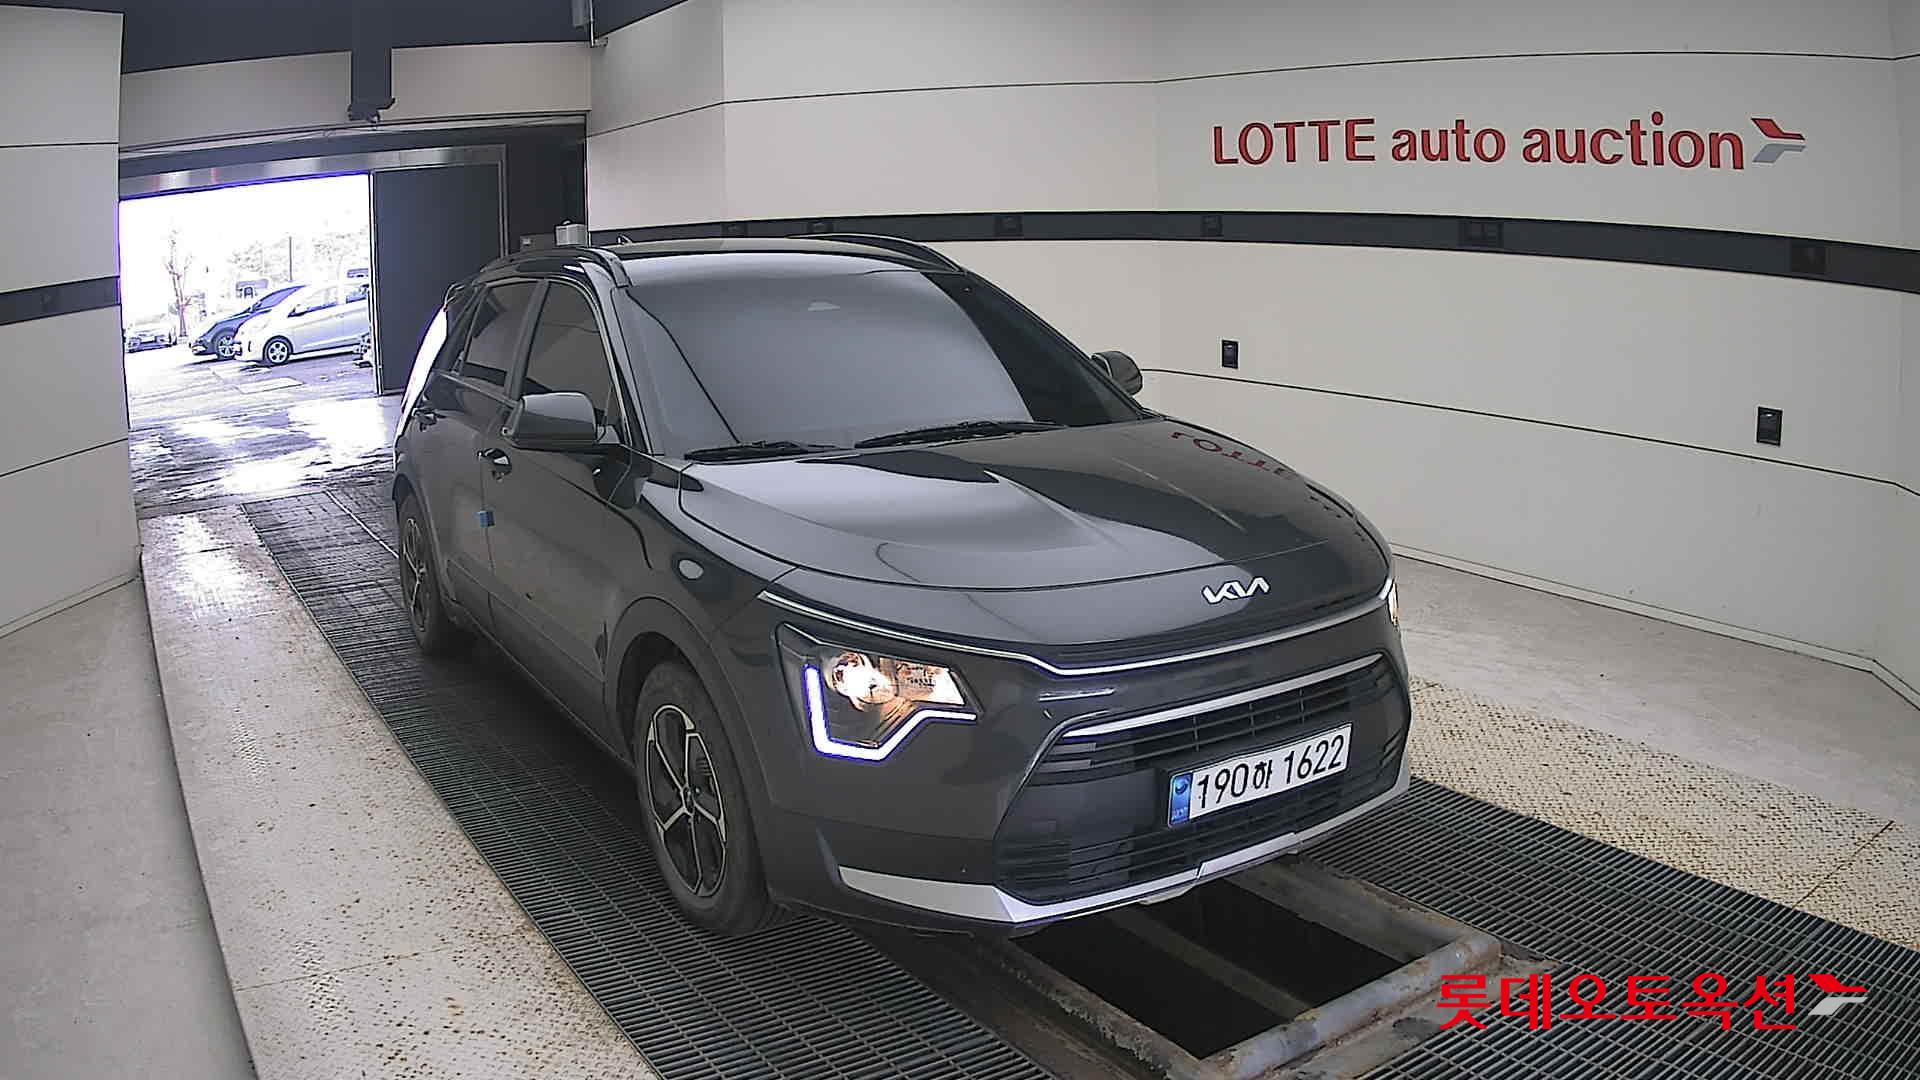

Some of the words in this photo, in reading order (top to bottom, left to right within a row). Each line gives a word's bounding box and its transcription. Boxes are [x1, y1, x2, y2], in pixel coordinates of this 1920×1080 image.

[1213, 118, 1376, 166] LOTTE
[1391, 120, 1506, 163] auto
[1522, 111, 1744, 171] auction
[1202, 577, 1270, 604] KIA
[1197, 760, 1273, 809] 190하
[1284, 734, 1344, 785] 1622
